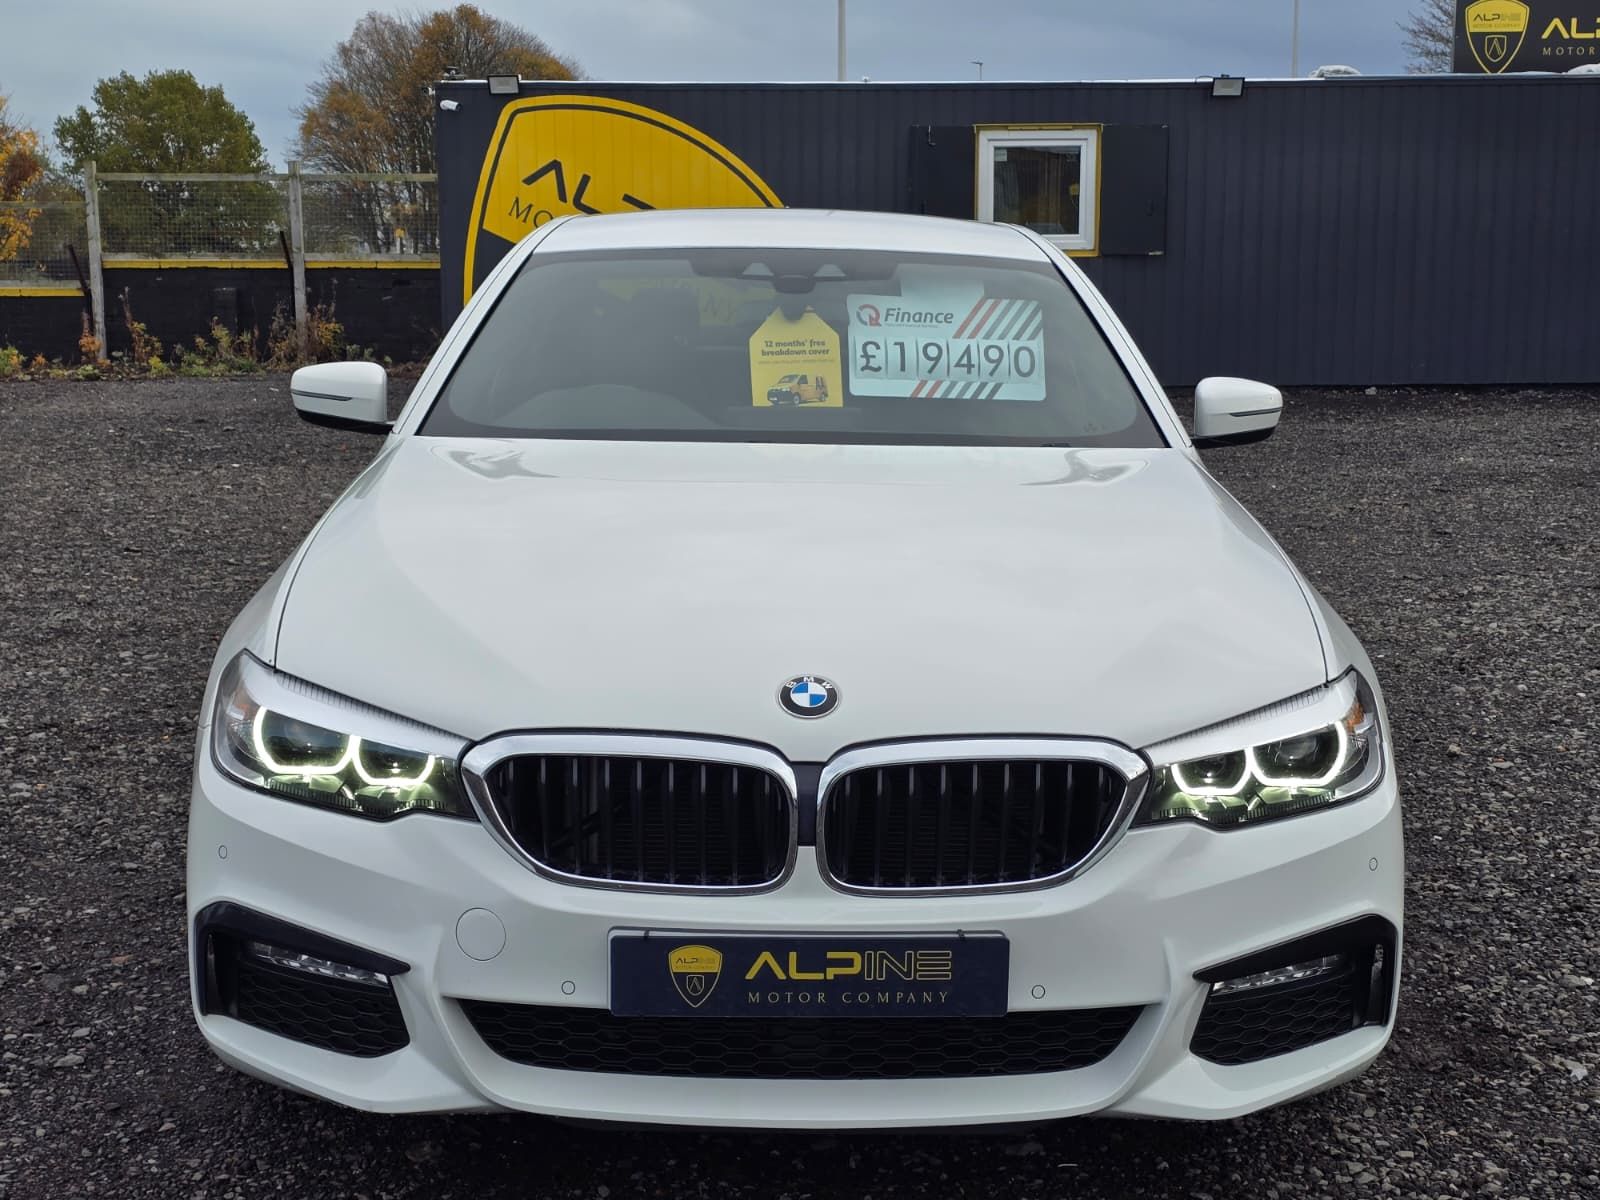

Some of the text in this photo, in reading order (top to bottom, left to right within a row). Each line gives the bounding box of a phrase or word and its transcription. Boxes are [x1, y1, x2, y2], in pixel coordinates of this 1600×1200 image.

[1542, 46, 1596, 56] MOTOR
[884, 308, 954, 324] Finance
[764, 340, 774, 348] 12
[810, 339, 826, 348] free
[761, 348, 807, 356] breakdown
[860, 340, 1036, 379] £19490
[784, 675, 834, 689] BMW
[744, 951, 953, 980] ALPINE
[747, 991, 948, 1004] MOTOR COMPANY
